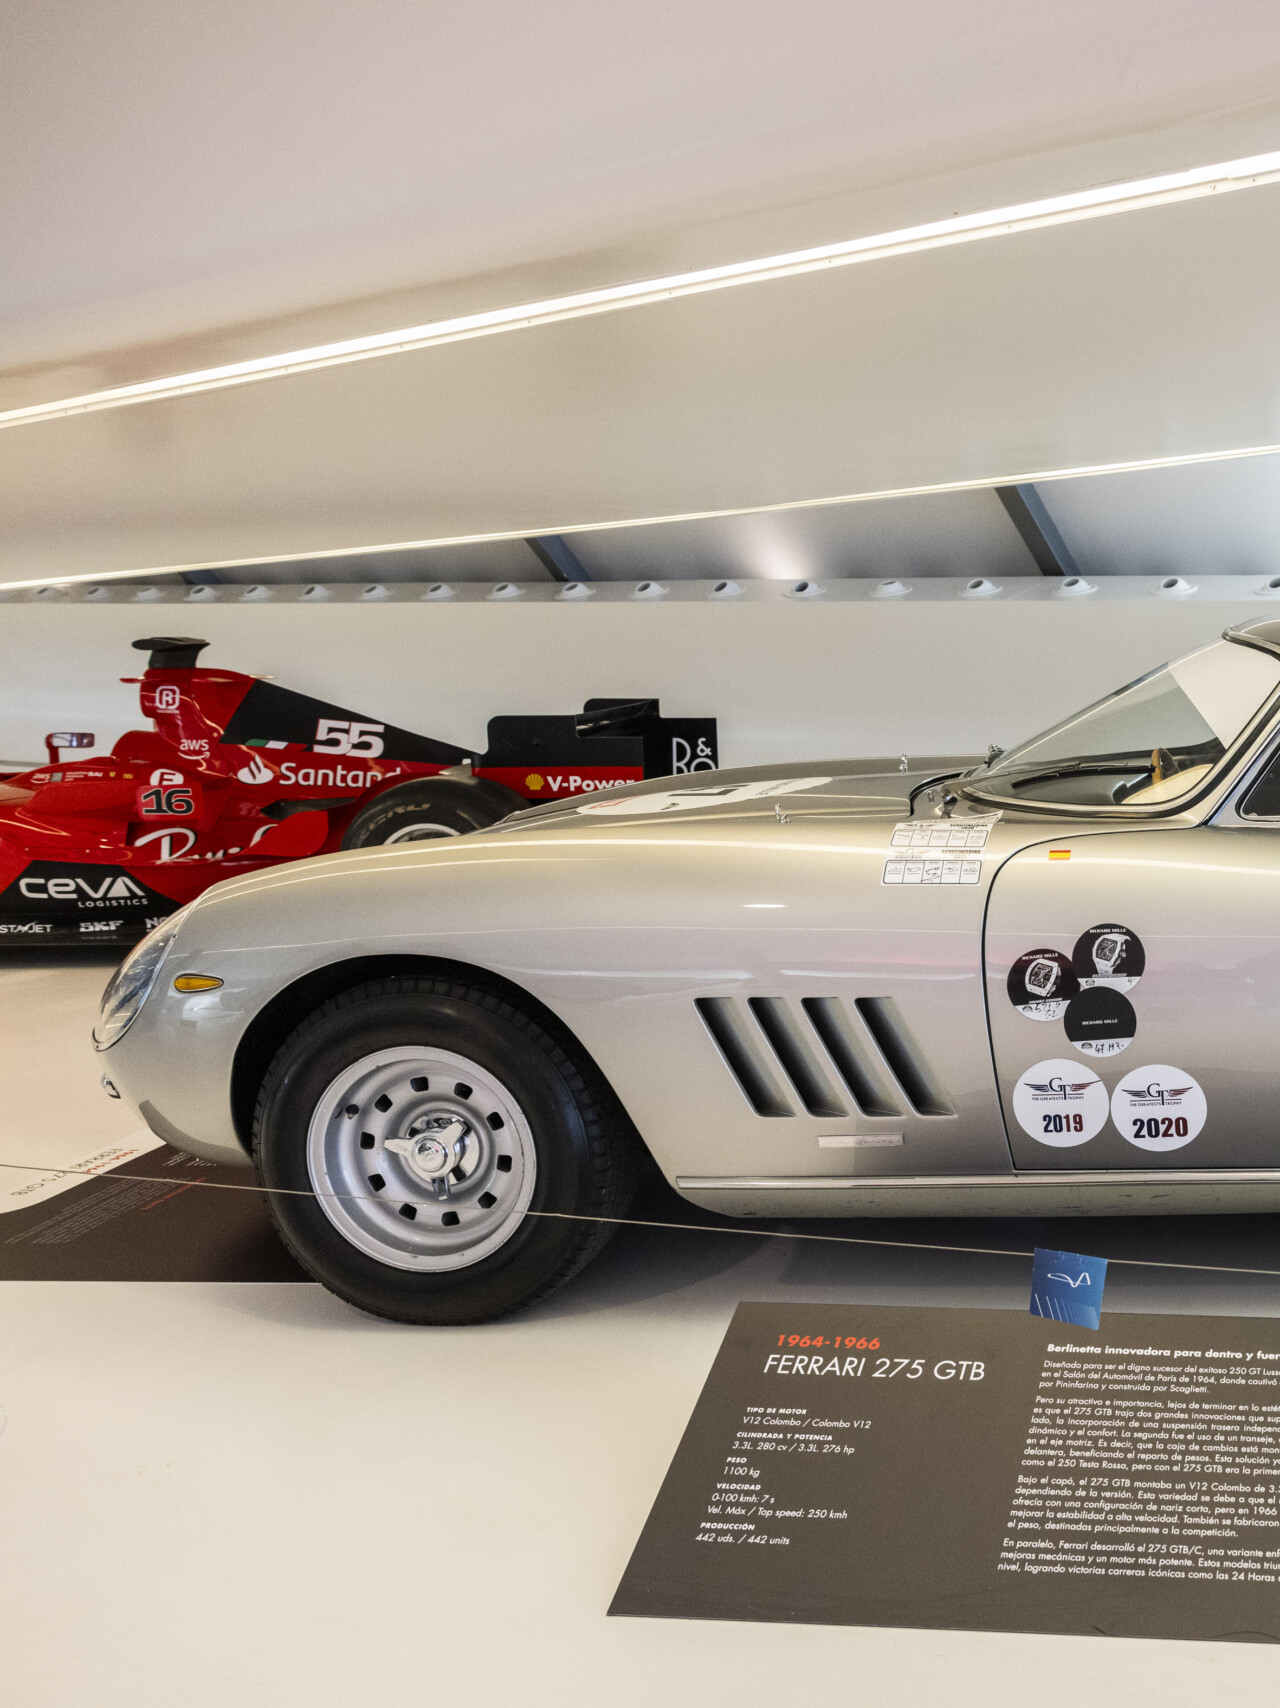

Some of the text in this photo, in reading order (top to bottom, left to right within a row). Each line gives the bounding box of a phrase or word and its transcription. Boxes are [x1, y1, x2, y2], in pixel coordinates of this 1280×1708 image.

[180, 738, 209, 751] aws
[313, 718, 385, 759] 55
[278, 761, 402, 789] Santan
[142, 787, 193, 815] 16
[77, 898, 149, 908] LOGISTICS
[0, 921, 54, 934] STAJET
[79, 920, 125, 932] SKF
[1048, 1077, 1071, 1100] GT
[1146, 1082, 1169, 1105] GT
[1042, 1113, 1084, 1133] 2019
[1132, 1116, 1189, 1139] 2020
[777, 1333, 880, 1350] 1964-1966
[1046, 1343, 1102, 1353] Berlinetta
[1104, 1344, 1171, 1356] innovadora
[1173, 1350, 1202, 1358] para
[1204, 1348, 1243, 1358] dentro
[1245, 1352, 1254, 1361] y
[763, 1354, 985, 1381] FERRARI 275 GTB
[743, 1415, 871, 1428] V12 Colombo / Colombo V12
[736, 1431, 783, 1439] CILINDRADA
[793, 1433, 832, 1441] POTENCIA
[732, 1440, 753, 1449] 3.3L.
[756, 1441, 776, 1450] 280
[788, 1442, 797, 1452] /
[797, 1443, 819, 1452] 3.3L.
[822, 1444, 841, 1453] 276
[842, 1444, 855, 1455] hp
[723, 1466, 761, 1478] 1100 kg
[716, 1482, 761, 1490] VELOCIDAD
[711, 1492, 738, 1502] 0-100
[738, 1493, 759, 1503] kmh:
[760, 1494, 770, 1503] 7
[707, 1504, 847, 1519] Vel. Máx / Top speed: 250 kmh
[699, 1521, 755, 1530] PRODUCCIÓN
[1006, 1518, 1016, 1528] el
[1017, 1521, 1041, 1530] peso,
[1044, 1520, 1092, 1531] destinadas
[1093, 1523, 1159, 1534] principalmente
[1170, 1525, 1180, 1535] la
[1181, 1528, 1238, 1537] competición.
[694, 1532, 790, 1545] 442 uds. / 442 units
[997, 1561, 1021, 1572] nivel,
[1023, 1561, 1065, 1574] logrando
[1067, 1564, 1105, 1574] victorias
[1107, 1568, 1145, 1576] carreras
[1148, 1568, 1185, 1578] icónicas
[1187, 1571, 1213, 1579] como
[1215, 1569, 1229, 1580] las
[1231, 1570, 1245, 1580] 24
[1247, 1571, 1275, 1582] Horas
